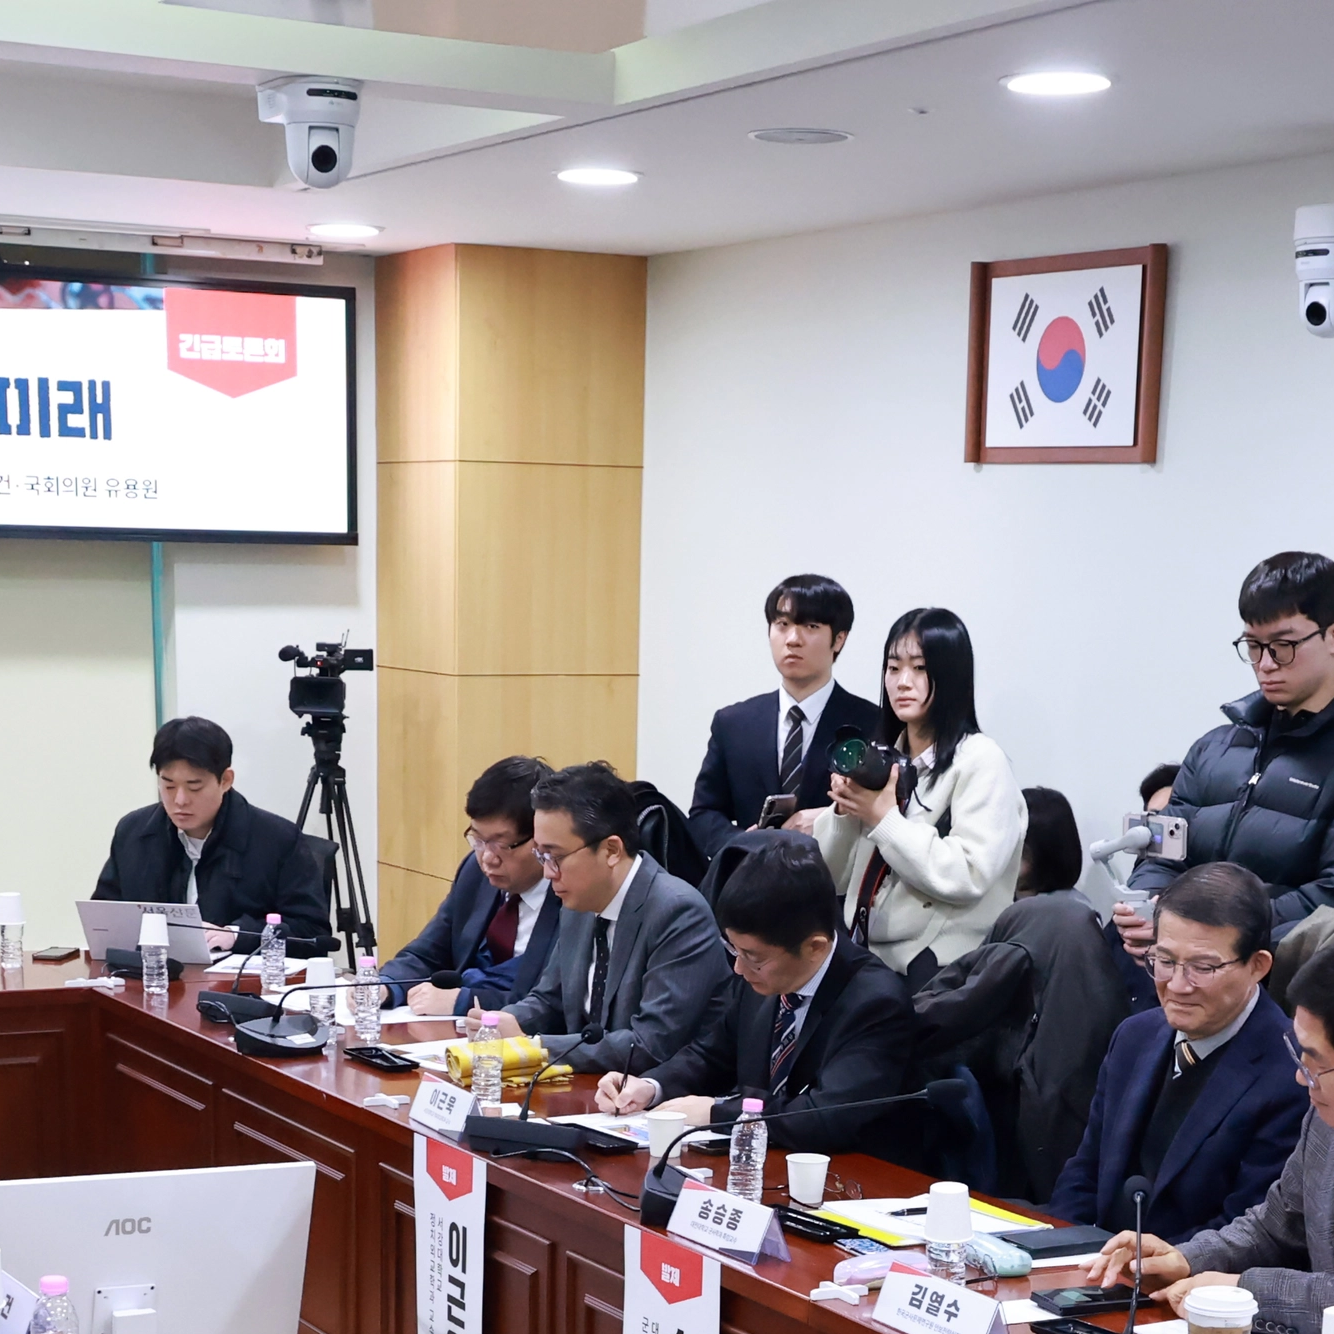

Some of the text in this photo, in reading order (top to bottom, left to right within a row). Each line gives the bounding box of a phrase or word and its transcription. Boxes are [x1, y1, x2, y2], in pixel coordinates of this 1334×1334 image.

[179, 333, 286, 364] 긴급토론회
[105, 476, 159, 500] 유용원
[429, 1088, 457, 1115] 이근욱
[103, 1217, 152, 1237] AOC
[698, 1199, 743, 1231] 송승종
[908, 1283, 960, 1323] 김열수
